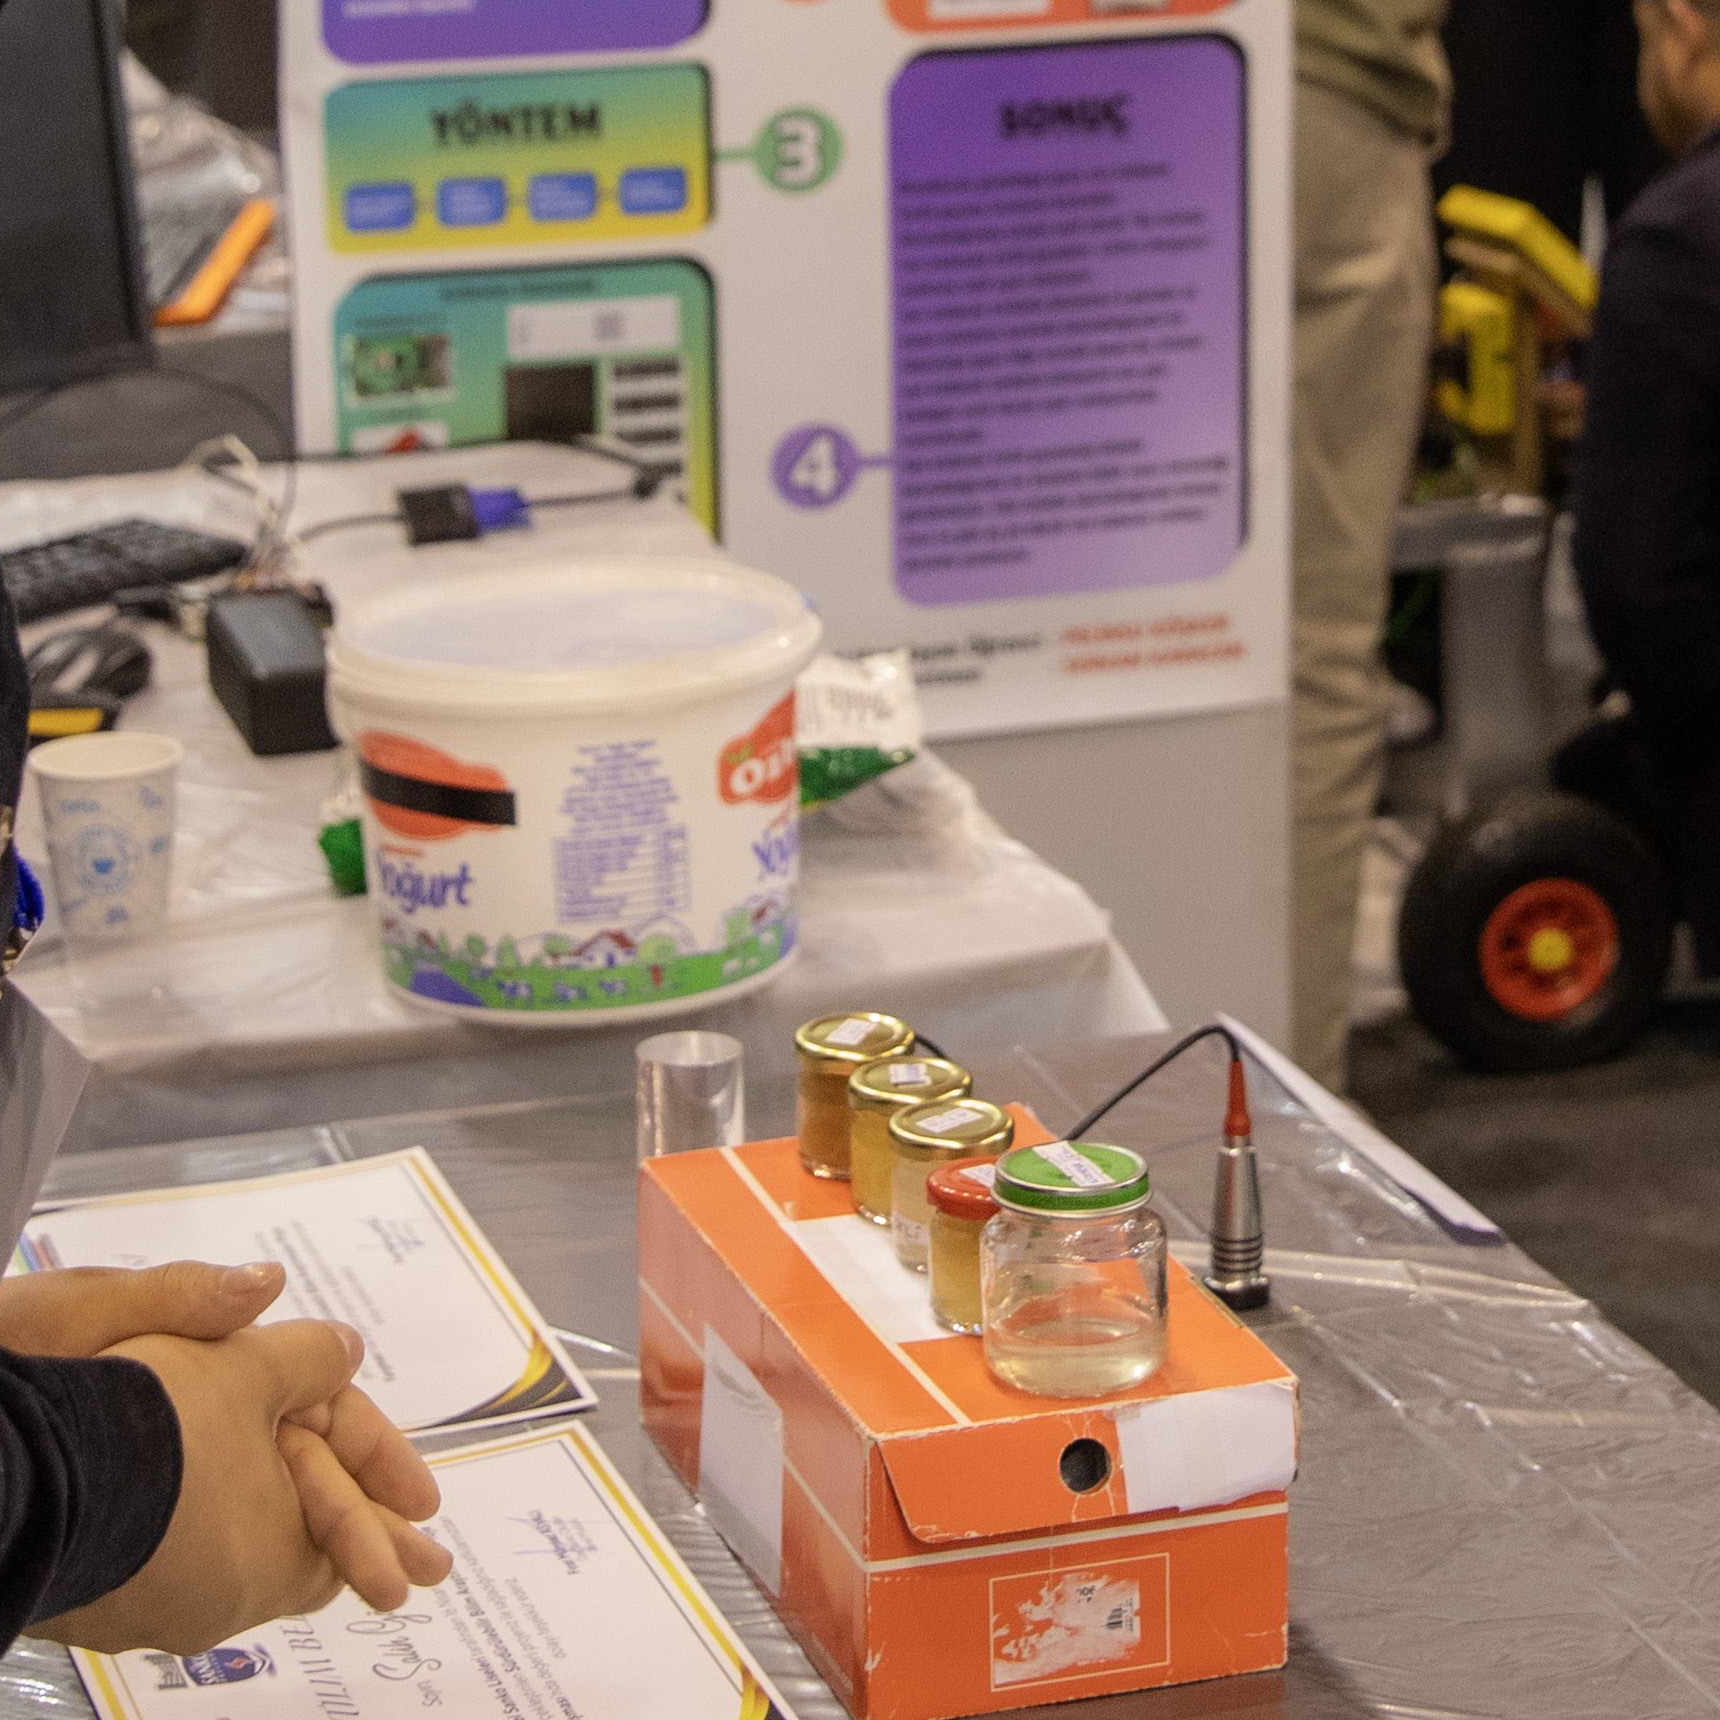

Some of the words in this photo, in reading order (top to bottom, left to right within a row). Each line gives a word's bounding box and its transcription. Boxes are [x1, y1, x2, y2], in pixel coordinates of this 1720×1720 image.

[430, 100, 601, 145] YÖNTEM
[1000, 94, 1131, 138] SONUÇ
[772, 121, 822, 182] 3
[787, 434, 834, 497] 4
